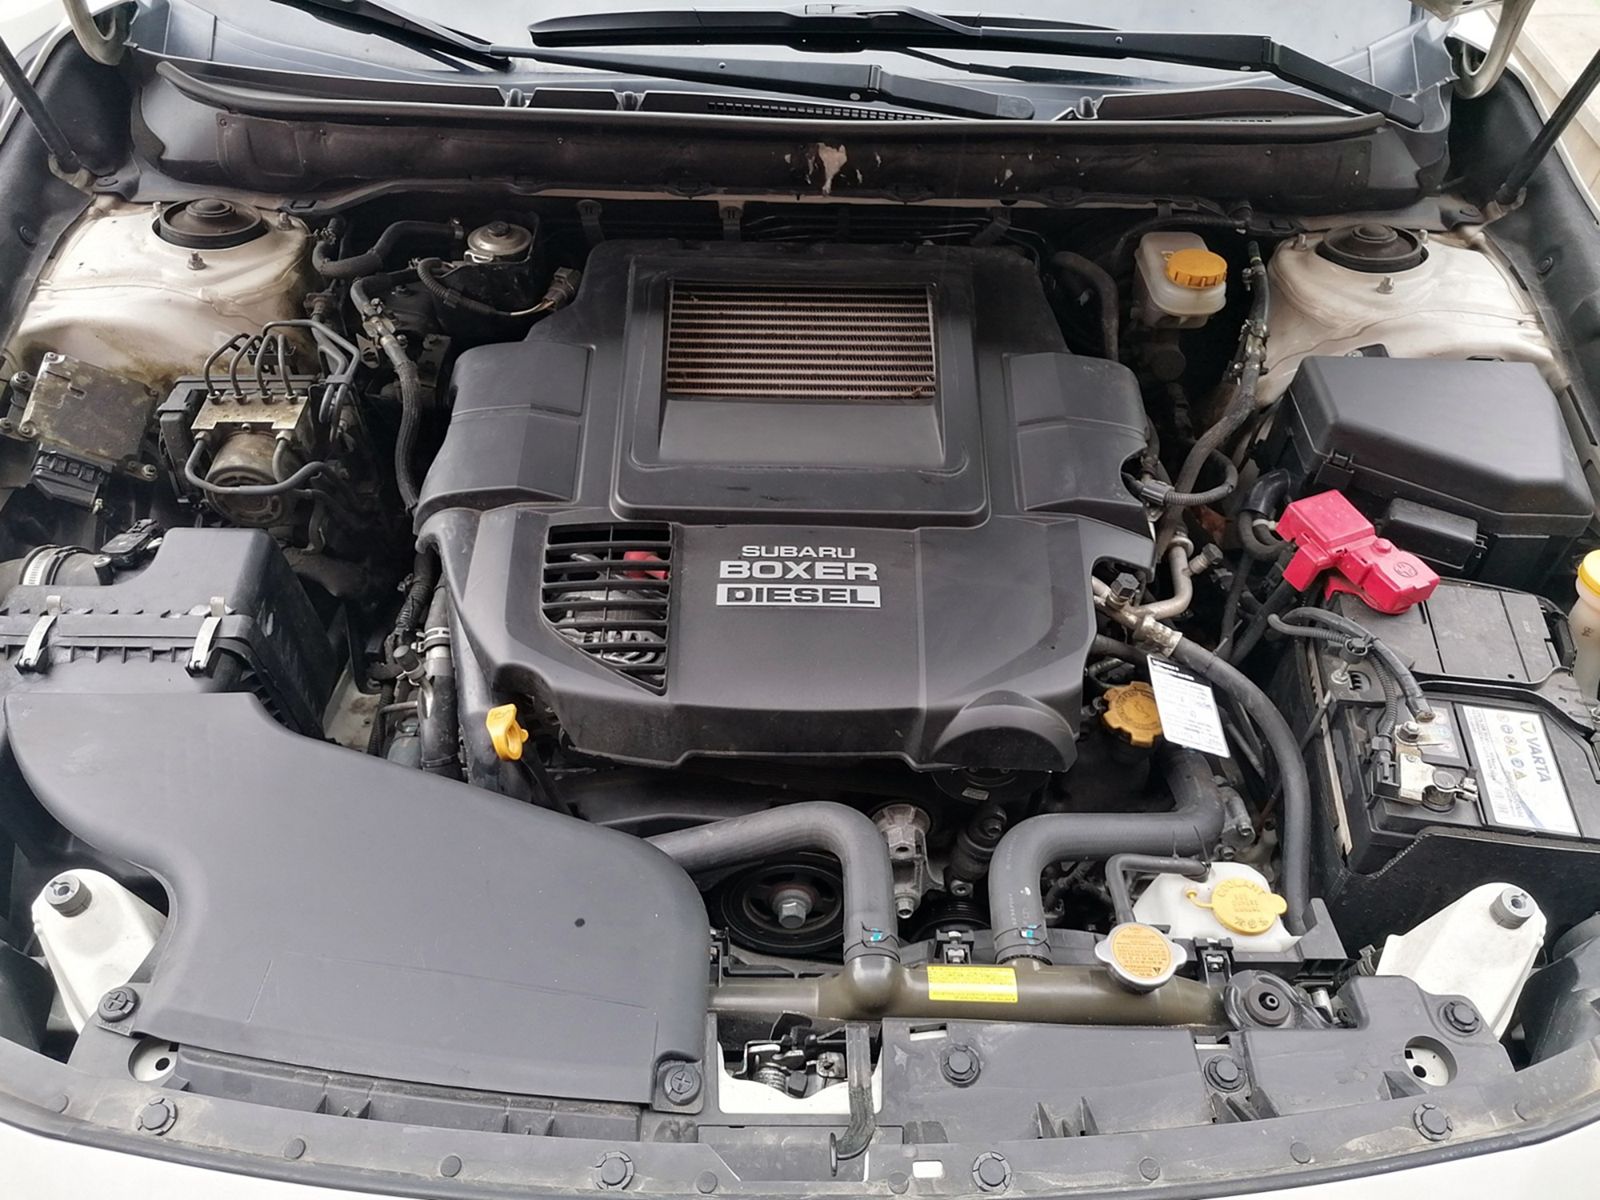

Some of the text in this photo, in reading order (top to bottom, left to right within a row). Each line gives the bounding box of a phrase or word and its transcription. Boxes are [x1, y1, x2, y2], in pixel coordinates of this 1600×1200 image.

[742, 545, 855, 559] SUBARU
[719, 560, 878, 581] BOXER
[723, 586, 877, 605] DIESEL
[1526, 737, 1551, 782] VARTA
